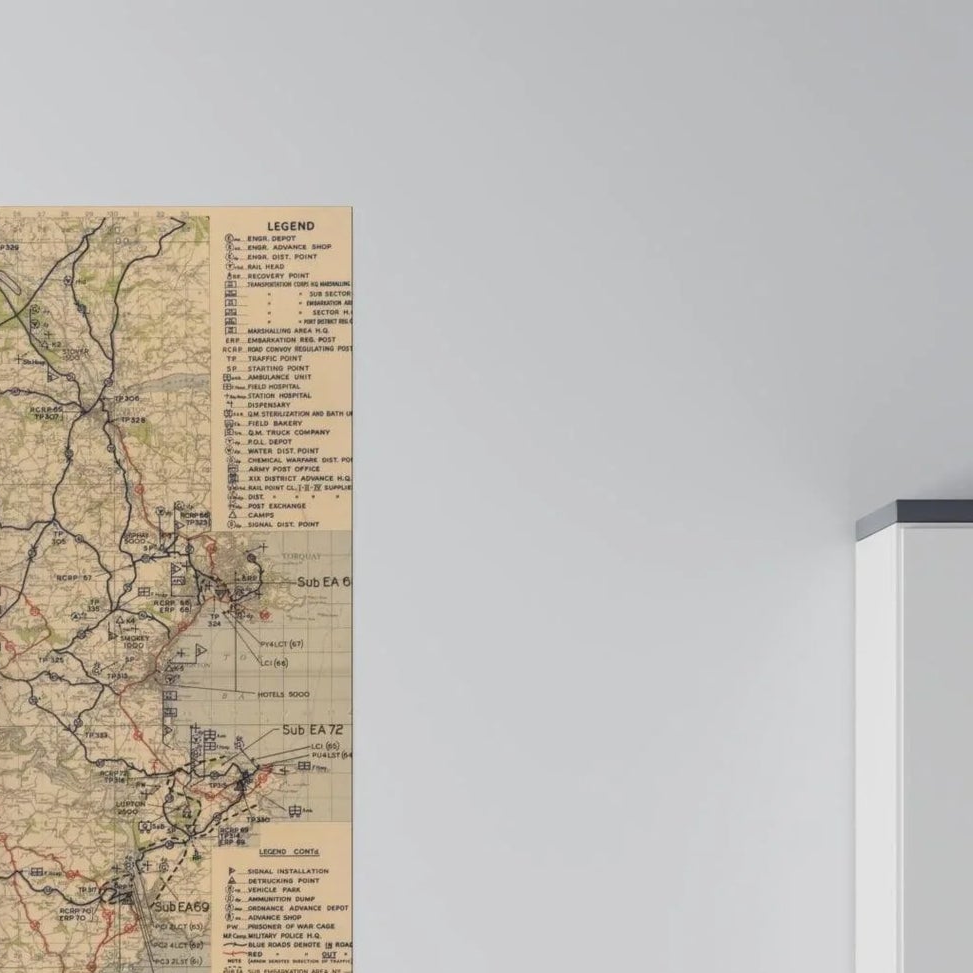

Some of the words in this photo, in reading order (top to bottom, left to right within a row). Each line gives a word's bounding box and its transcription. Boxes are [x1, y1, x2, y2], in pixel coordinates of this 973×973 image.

[267, 221, 315, 231] LEGEND
[298, 576, 320, 587] Sub
[323, 576, 339, 587] EA
[283, 724, 305, 735] Sub
[310, 724, 326, 735] EA
[329, 724, 343, 735] 72
[155, 901, 175, 912] Sub
